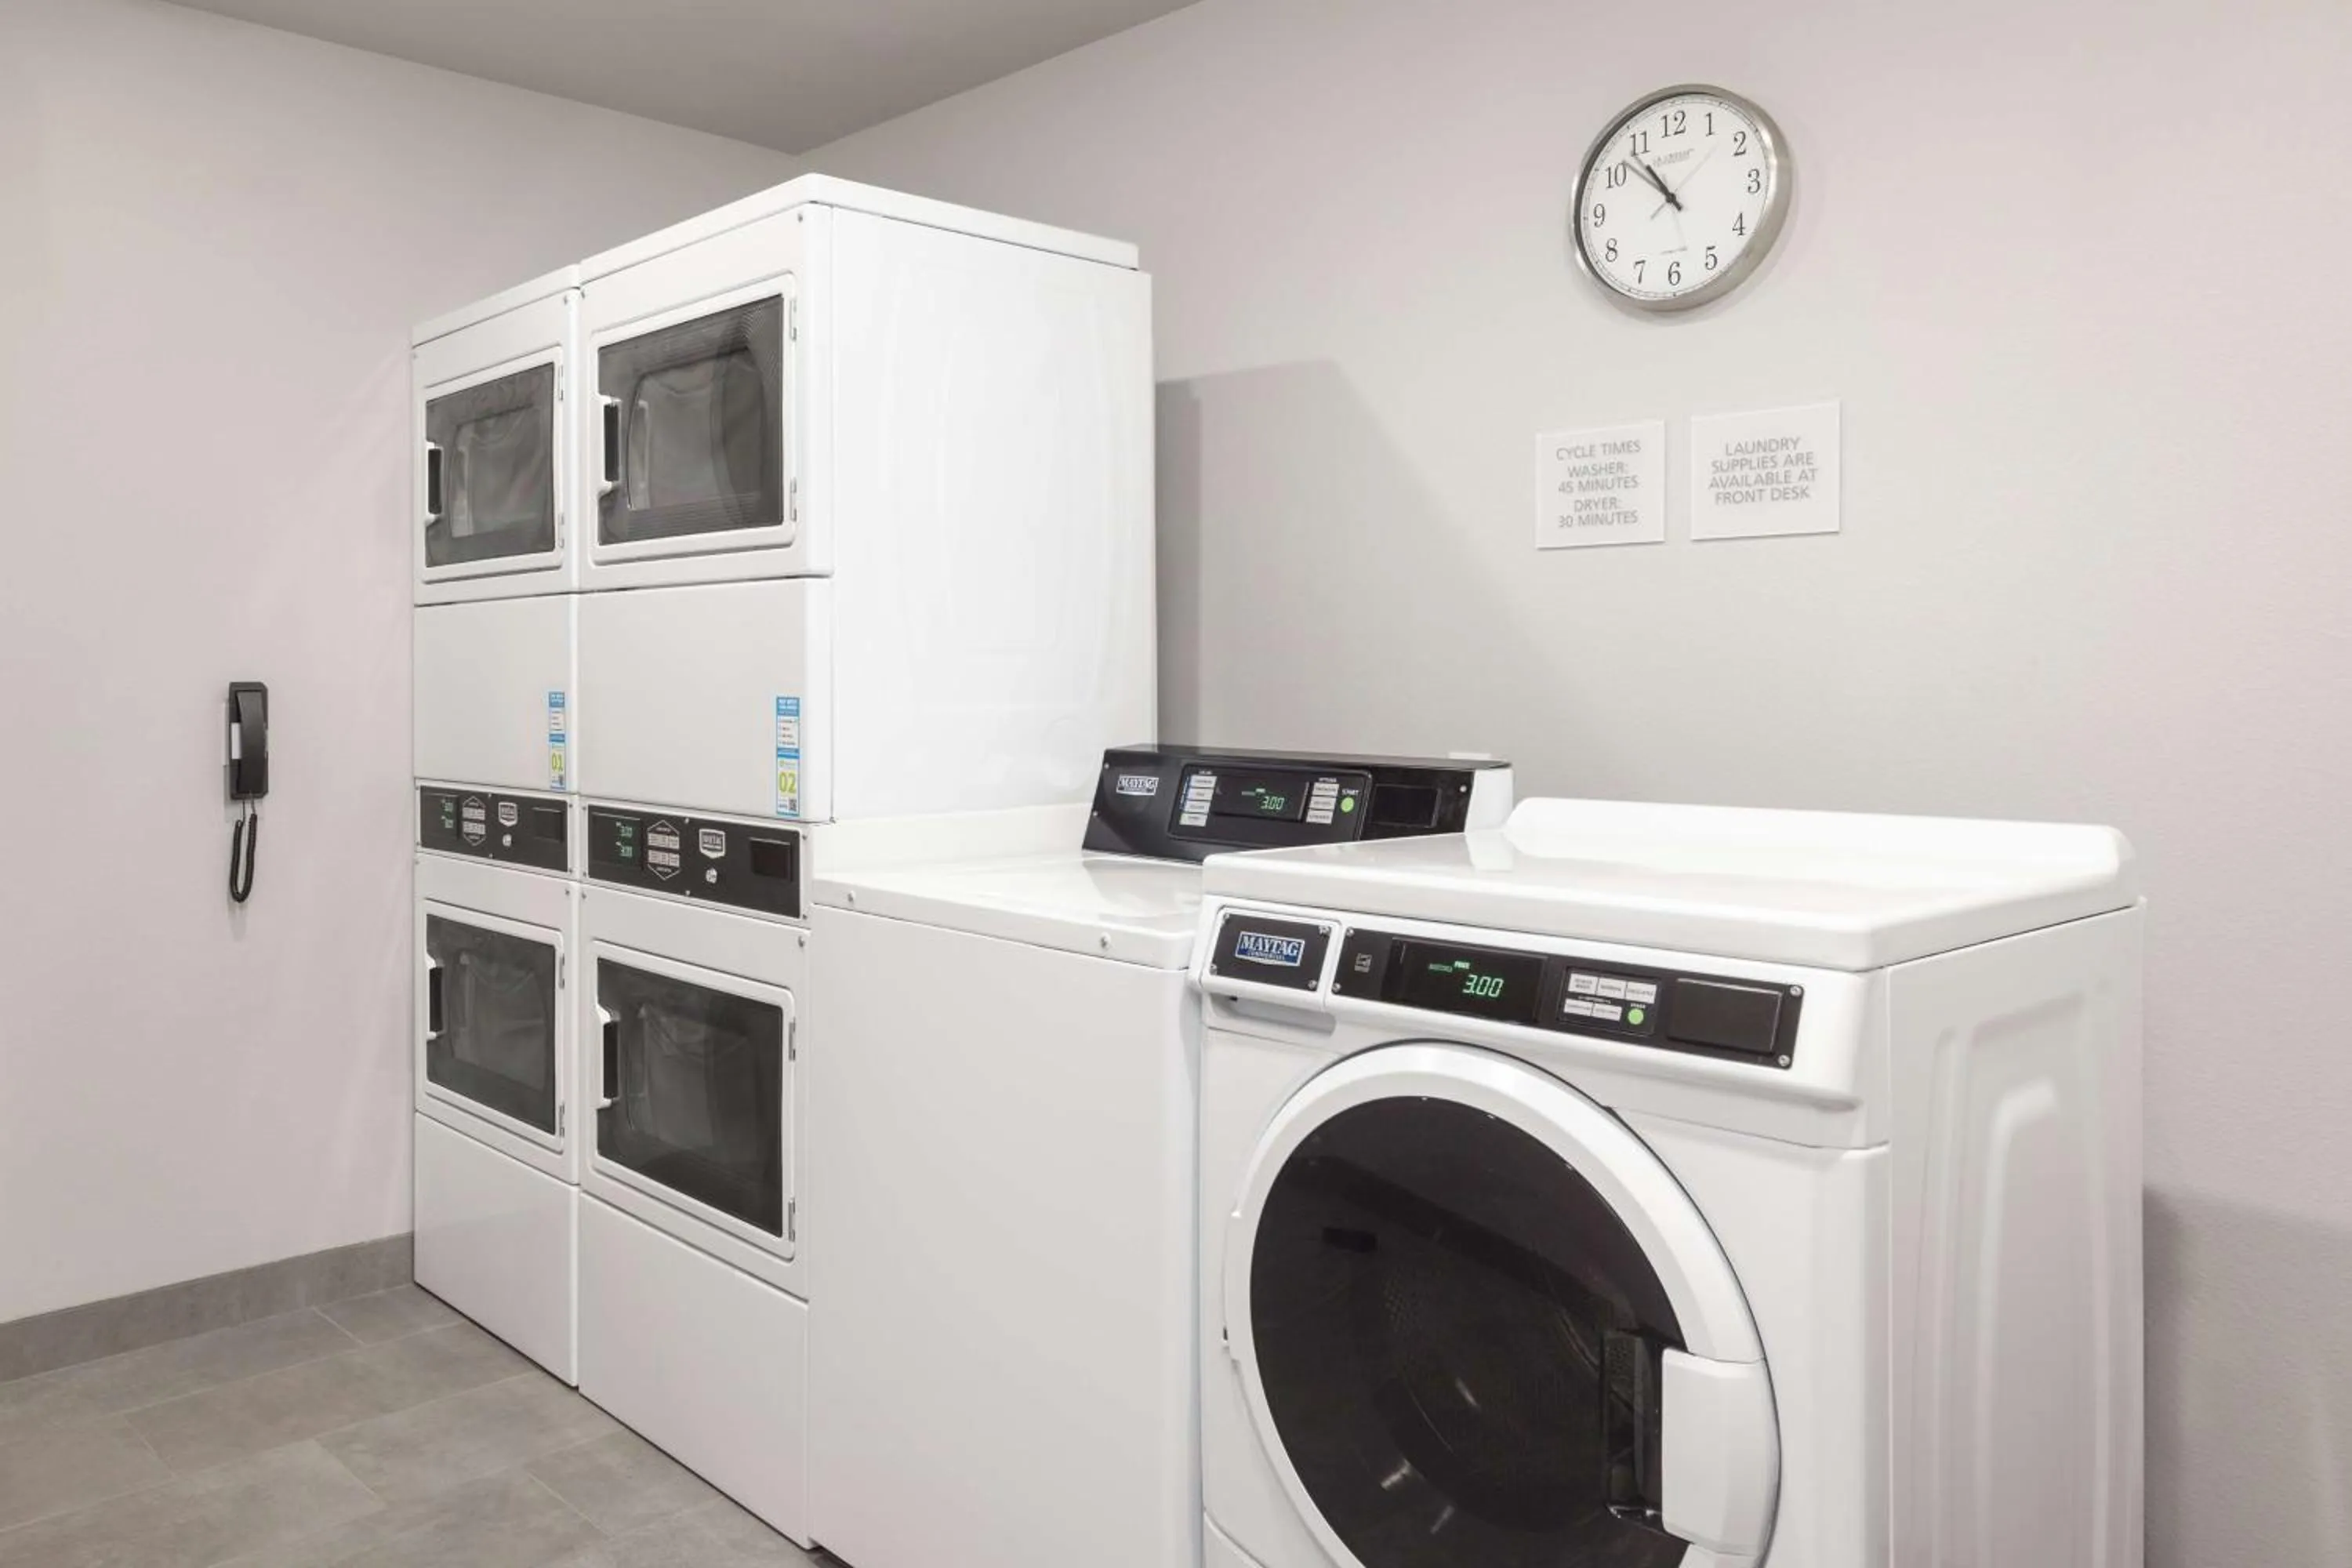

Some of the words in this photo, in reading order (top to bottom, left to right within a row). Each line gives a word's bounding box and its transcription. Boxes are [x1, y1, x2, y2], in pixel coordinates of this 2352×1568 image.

[1661, 110, 1686, 138] 12
[1705, 112, 1715, 136] 1
[1630, 131, 1650, 157] 11
[1733, 131, 1748, 157] 2
[1605, 162, 1627, 189] 10
[1747, 169, 1761, 194] 3
[1593, 203, 1606, 227] 9
[1732, 212, 1746, 236] 4
[1605, 238, 1618, 263] 8
[1704, 245, 1718, 270] 5
[1633, 260, 1646, 284] 7
[1668, 261, 1682, 285] 6
[1555, 445, 1595, 461] CYCLE
[1601, 439, 1642, 455] TIMES
[1726, 437, 1801, 456] LAUNDRY
[1567, 461, 1628, 477] WASHER:
[1711, 456, 1778, 474] SUPPLIES
[1783, 451, 1814, 467] ARE
[1558, 481, 1574, 493] 45
[1577, 474, 1639, 492] MINUTES
[1708, 470, 1792, 489] AVAILABLE
[1798, 468, 1818, 482] AT
[1715, 488, 1766, 506] FRONT
[1770, 485, 1810, 502] DESK
[1558, 515, 1573, 528] 30
[1577, 510, 1639, 527] MINUTES
[778, 771, 797, 794] 02
[1240, 935, 1299, 956] MAYTAG
